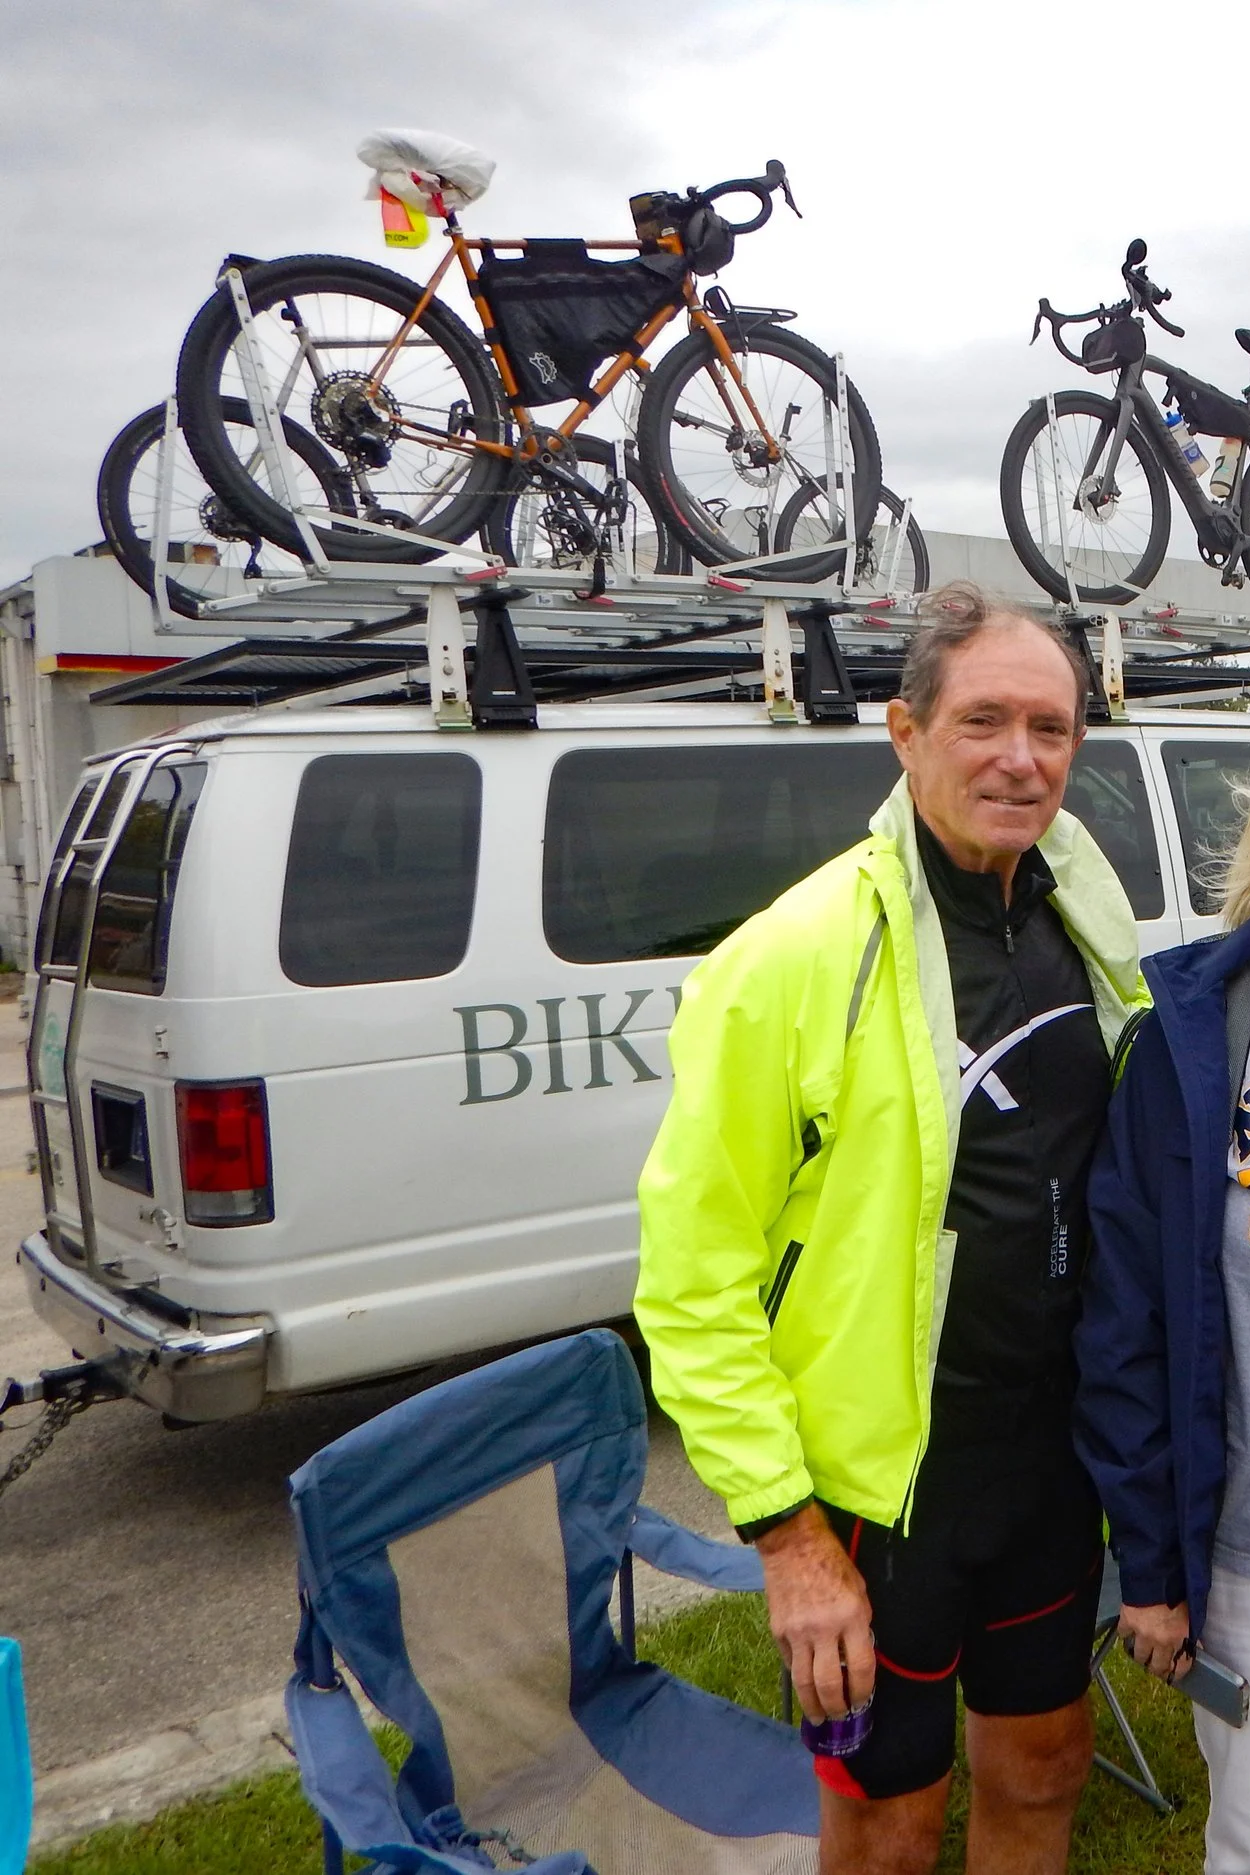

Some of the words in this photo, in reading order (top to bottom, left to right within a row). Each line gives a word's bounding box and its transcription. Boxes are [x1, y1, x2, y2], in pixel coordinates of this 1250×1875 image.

[1050, 1178, 1061, 1203] THE
[1050, 1206, 1060, 1278] ACCELERATE
[1058, 1224, 1068, 1275] CURE
